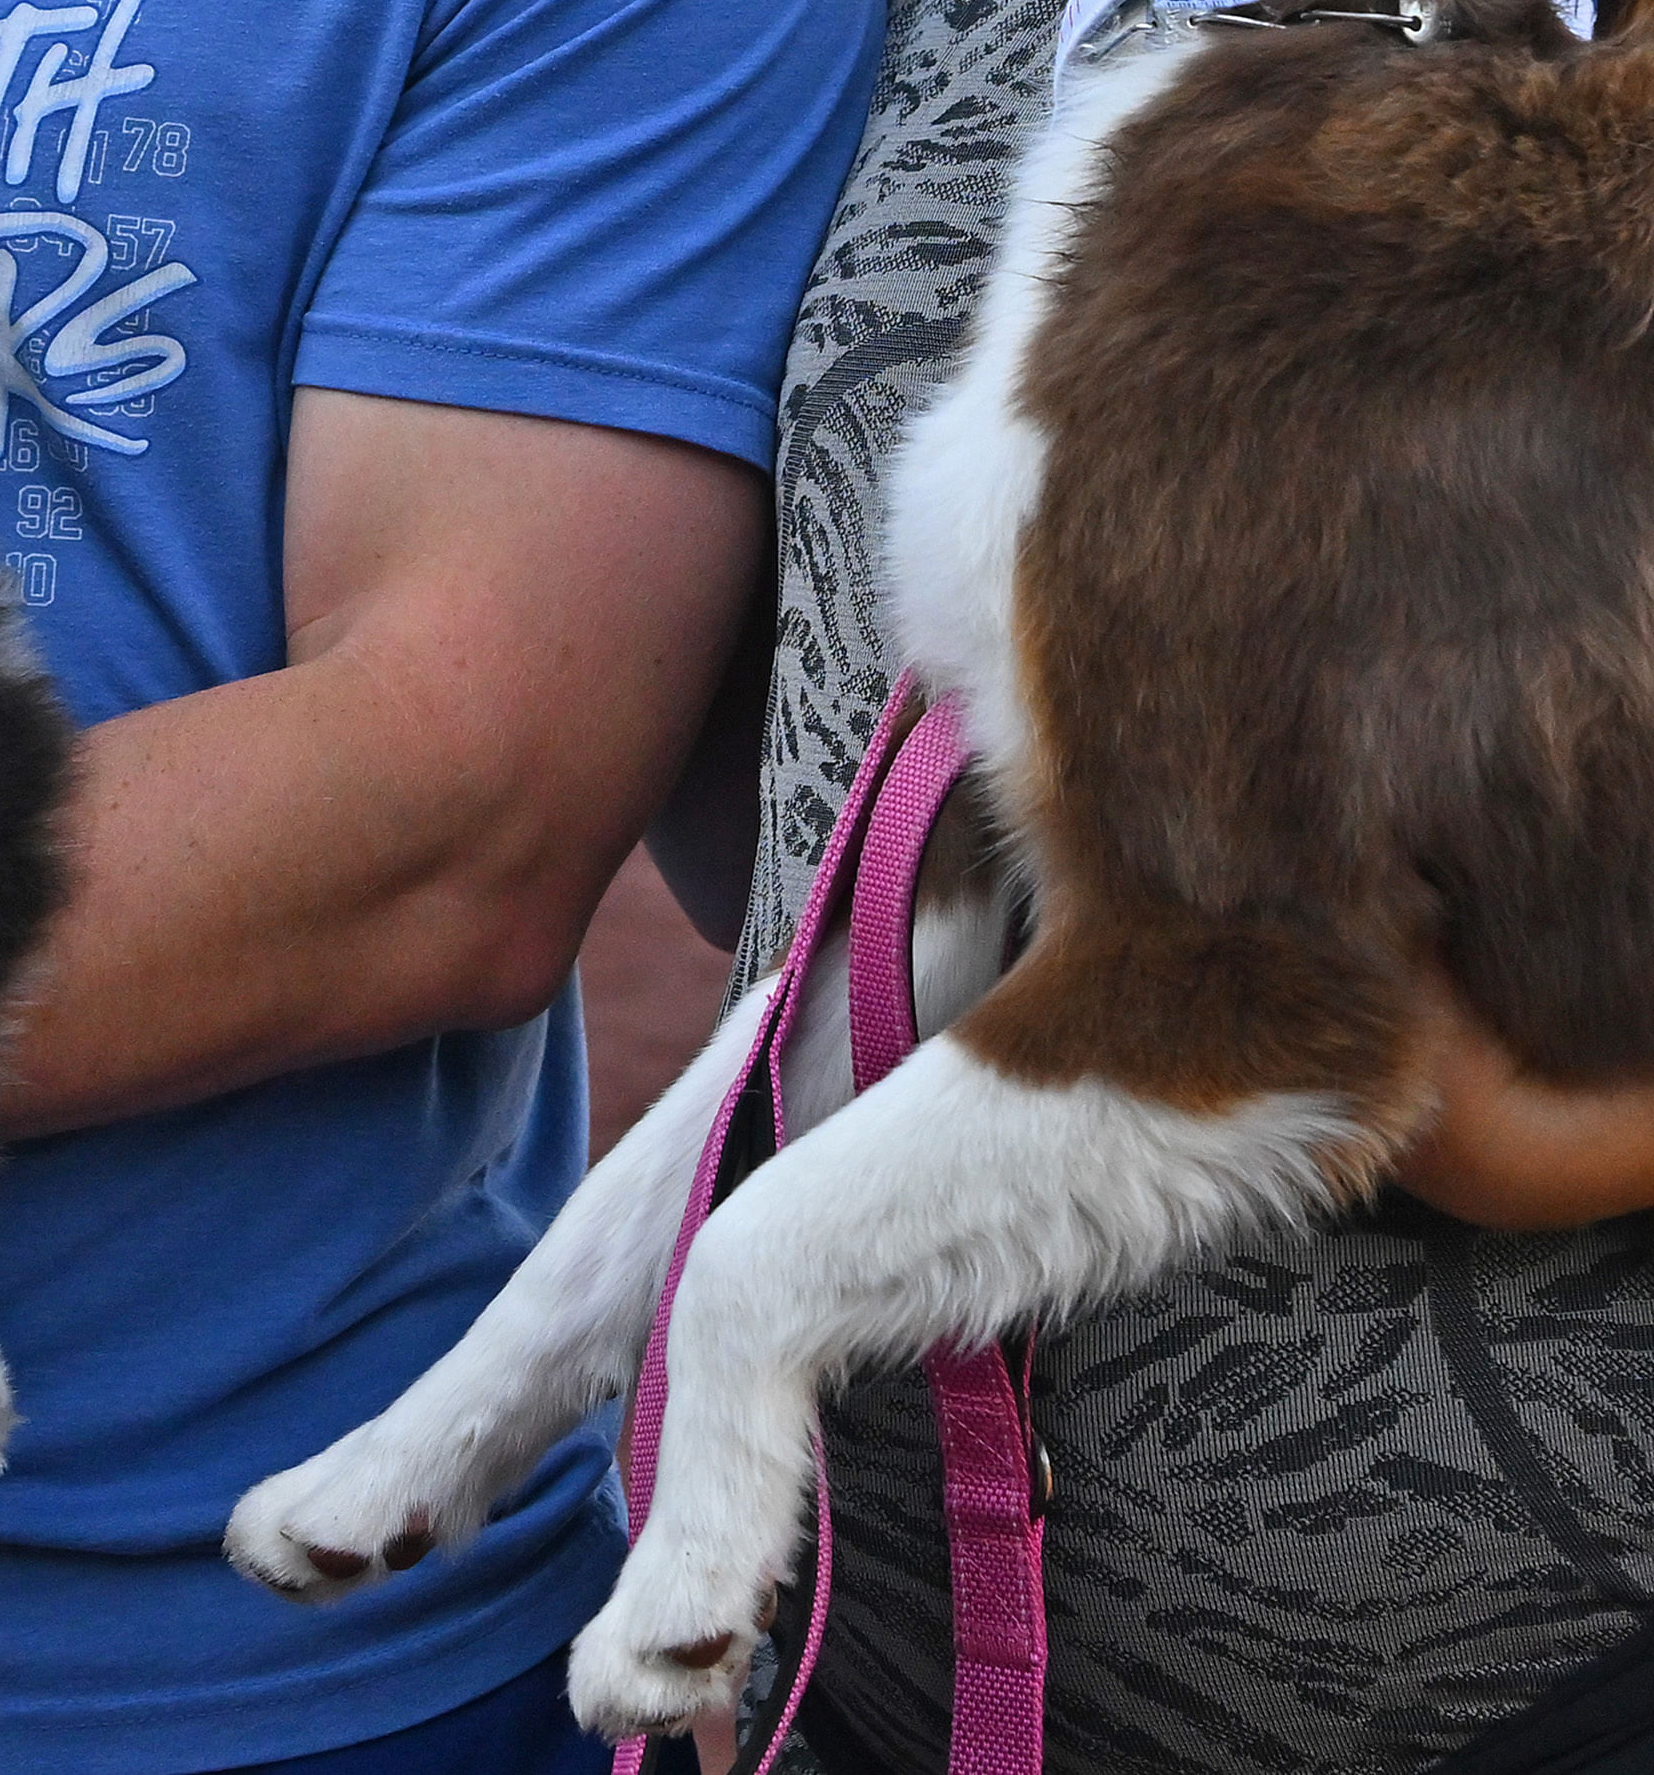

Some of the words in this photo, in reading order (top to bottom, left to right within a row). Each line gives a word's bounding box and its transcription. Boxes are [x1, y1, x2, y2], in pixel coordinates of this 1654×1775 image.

[123, 116, 190, 177] 78
[107, 214, 176, 271] 57
[16, 484, 84, 540] 92
